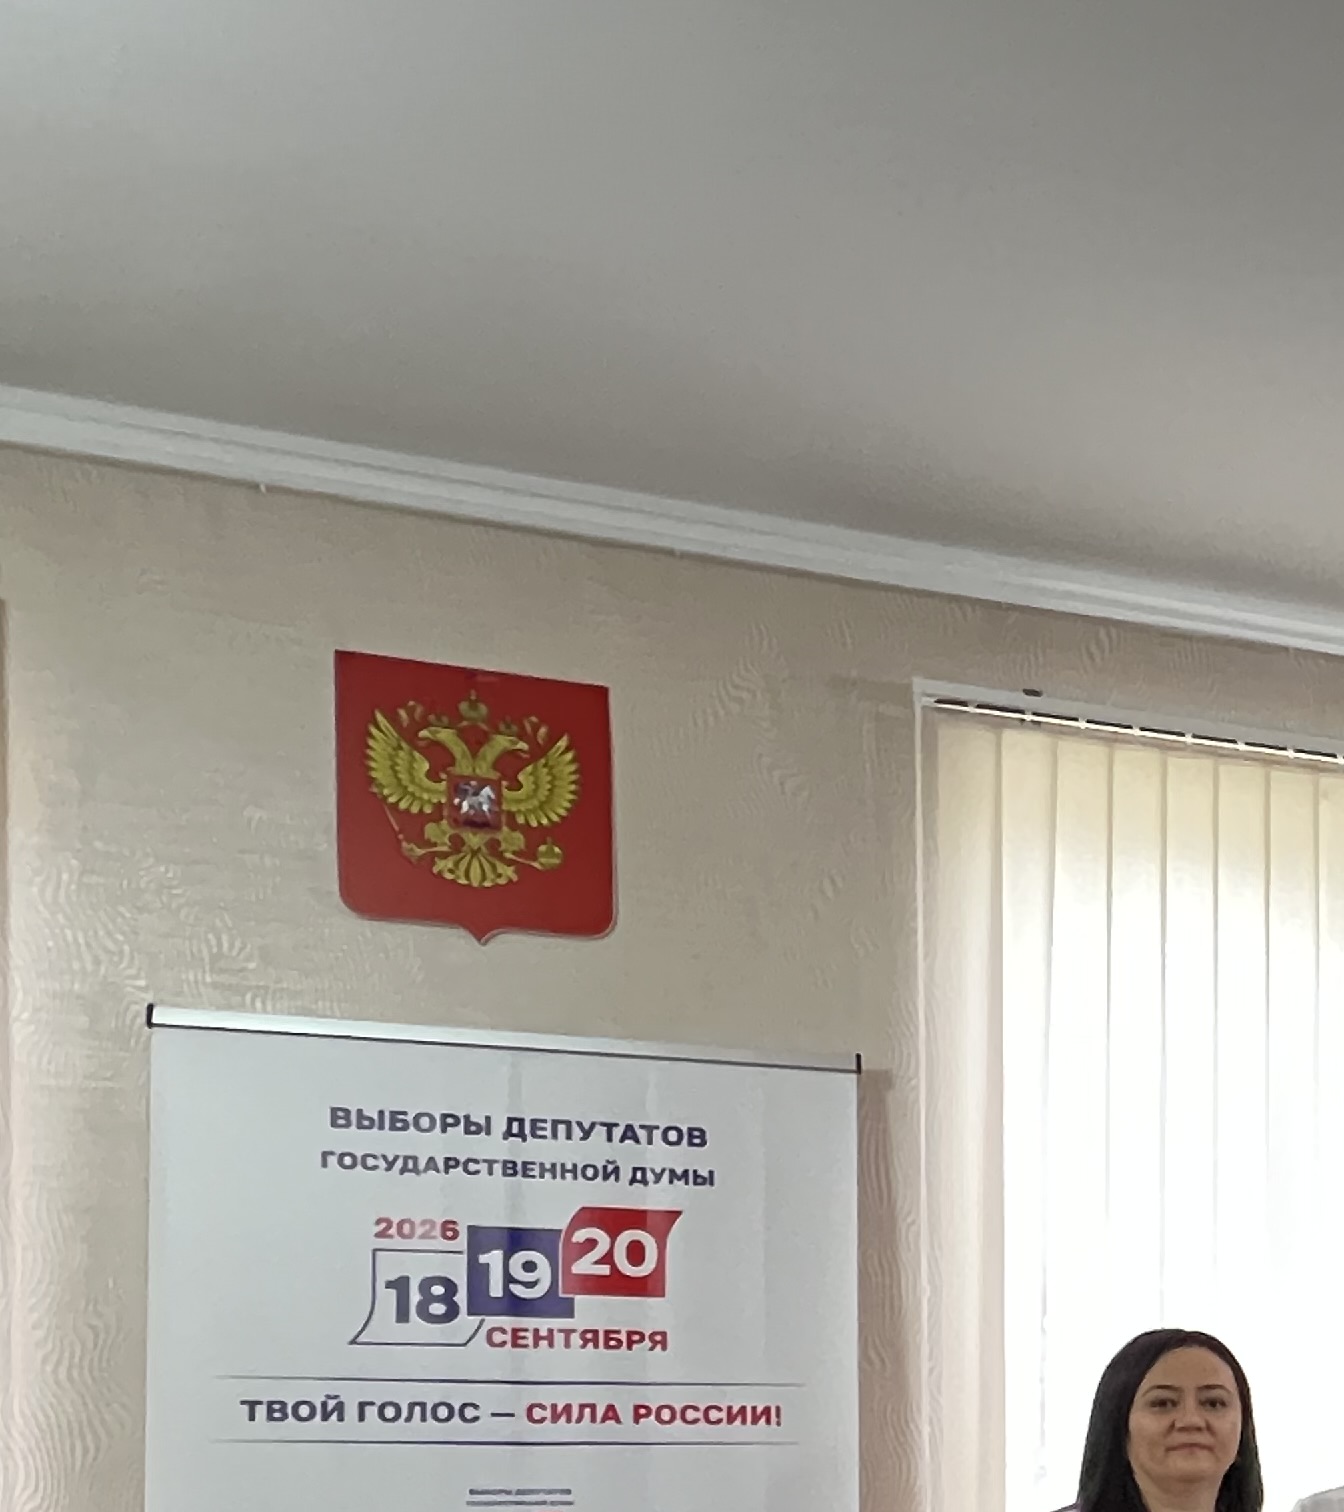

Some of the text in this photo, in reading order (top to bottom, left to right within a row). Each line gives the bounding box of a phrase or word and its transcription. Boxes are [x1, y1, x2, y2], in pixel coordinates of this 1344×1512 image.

[329, 1106, 708, 1148] ВЫБОРЫ ДЕПУТАТОВ
[320, 1150, 716, 1187] ГОСУДАРСТВЕННОЙ ДУМЫ
[373, 1217, 460, 1241] 2026
[385, 1227, 659, 1324] 18 19 20
[485, 1326, 669, 1351] СЕНТЯБРЯ
[240, 1393, 346, 1424] ТВОЙ
[357, 1401, 481, 1425] ГОЛОС
[526, 1402, 623, 1427] СИЛА
[632, 1404, 783, 1428] РОССИИ!
